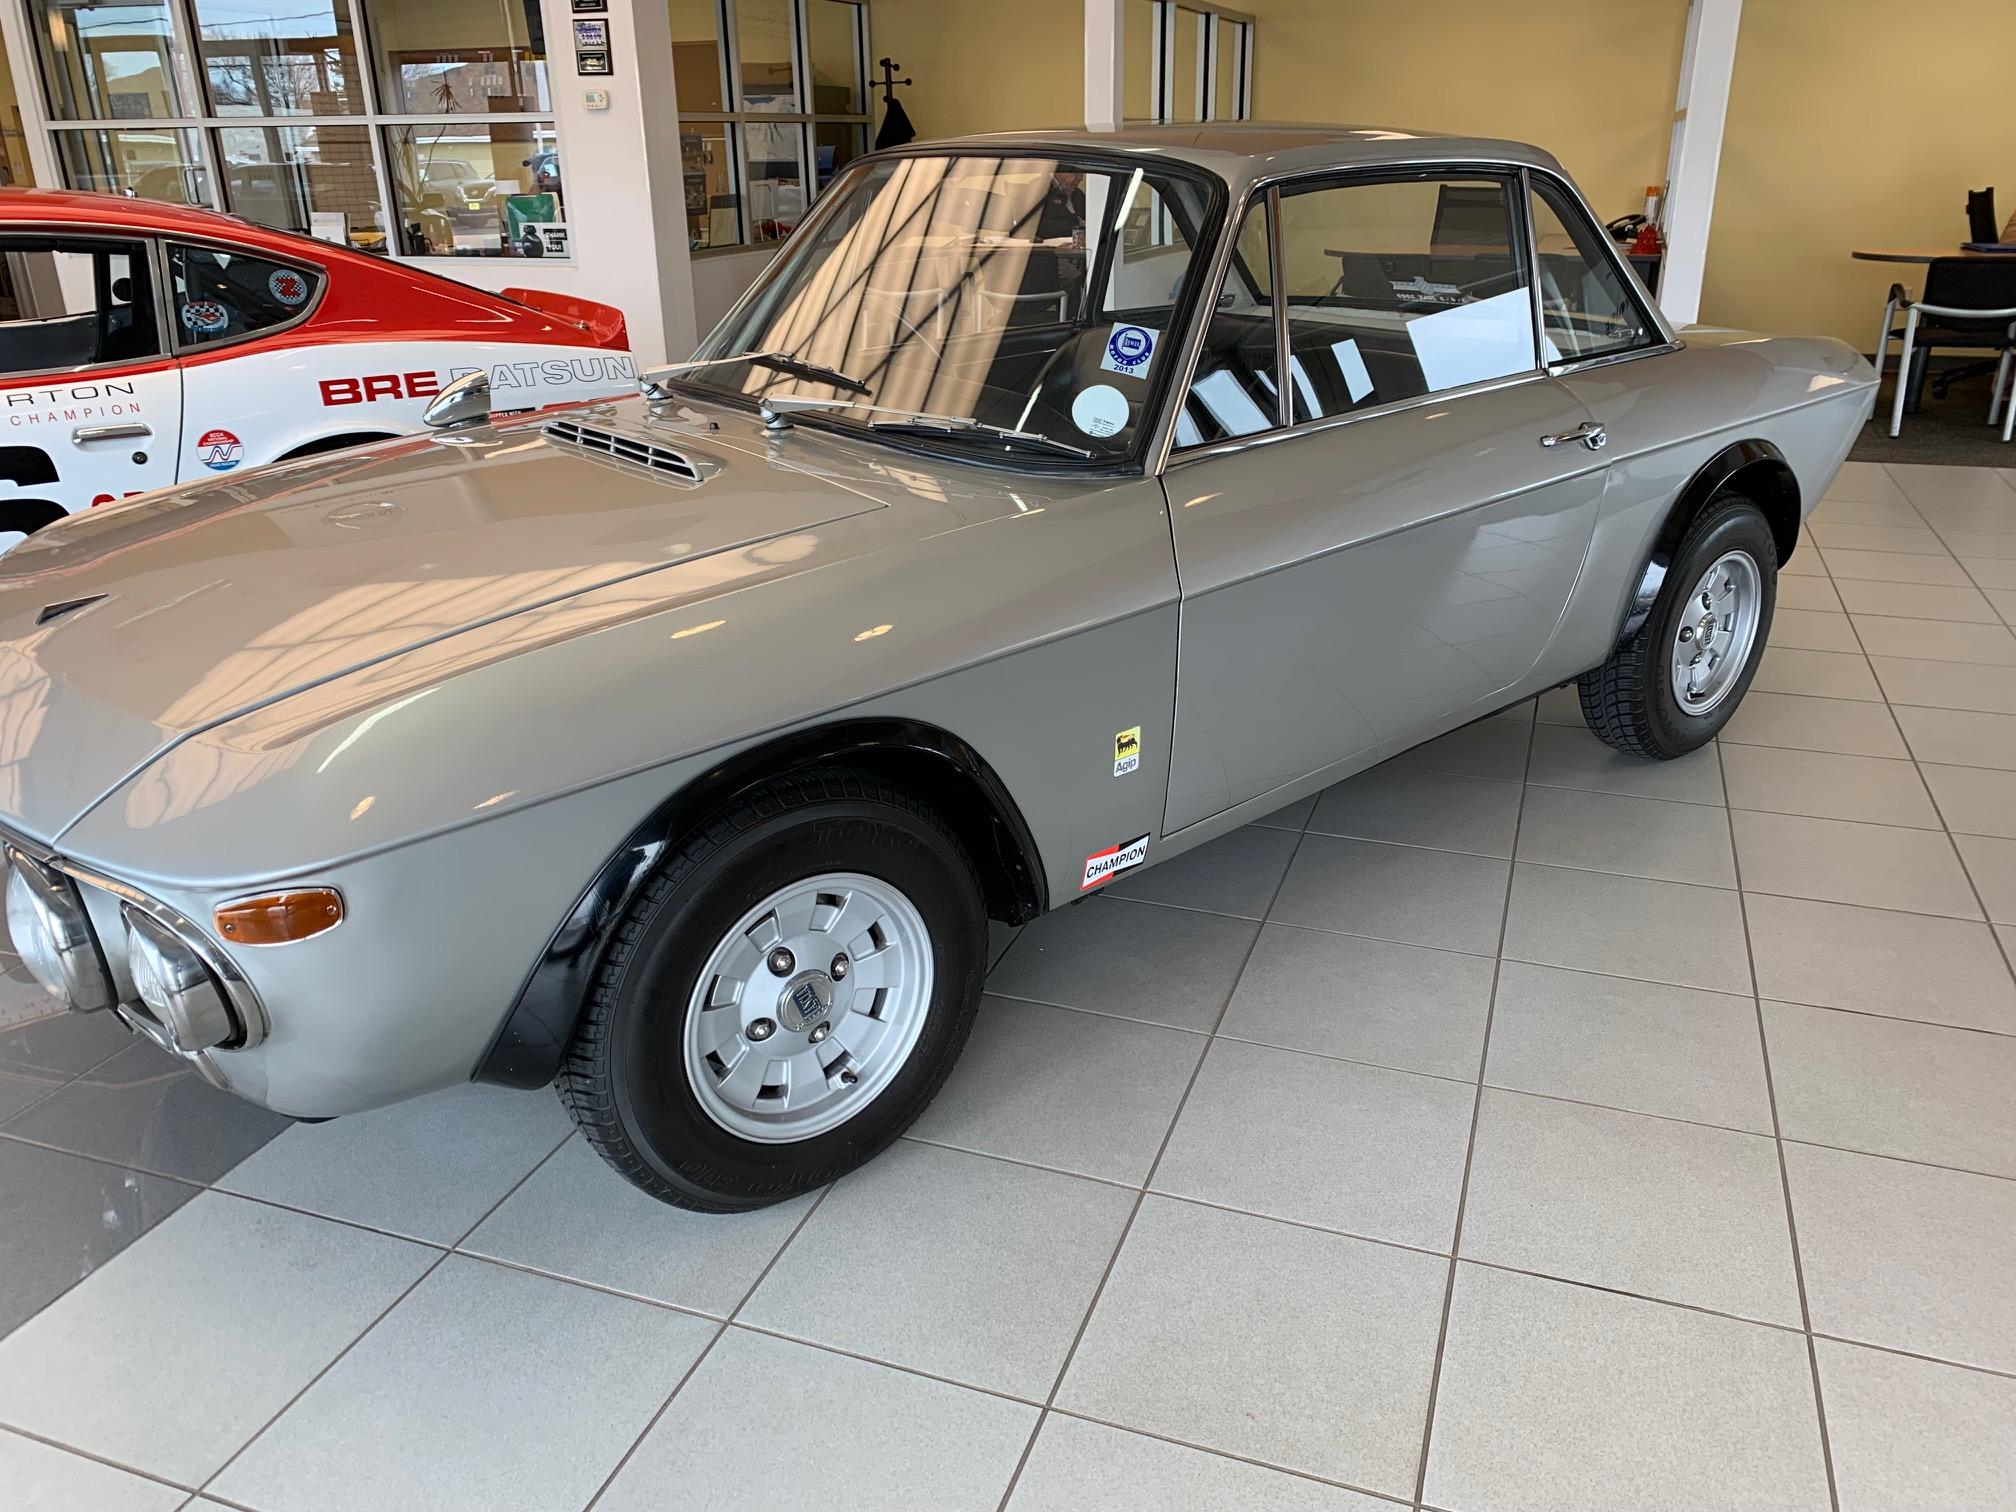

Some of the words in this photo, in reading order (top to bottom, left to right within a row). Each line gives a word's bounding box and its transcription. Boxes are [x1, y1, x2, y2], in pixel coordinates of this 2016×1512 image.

[1113, 364, 1134, 374] 2013
[1132, 351, 1150, 365] CLUB
[6, 382, 134, 407] RTON
[318, 371, 440, 407] BRE
[10, 402, 141, 426] CHAMPION
[1115, 758, 1137, 774] Agip
[1086, 845, 1146, 879] CHAMPION
